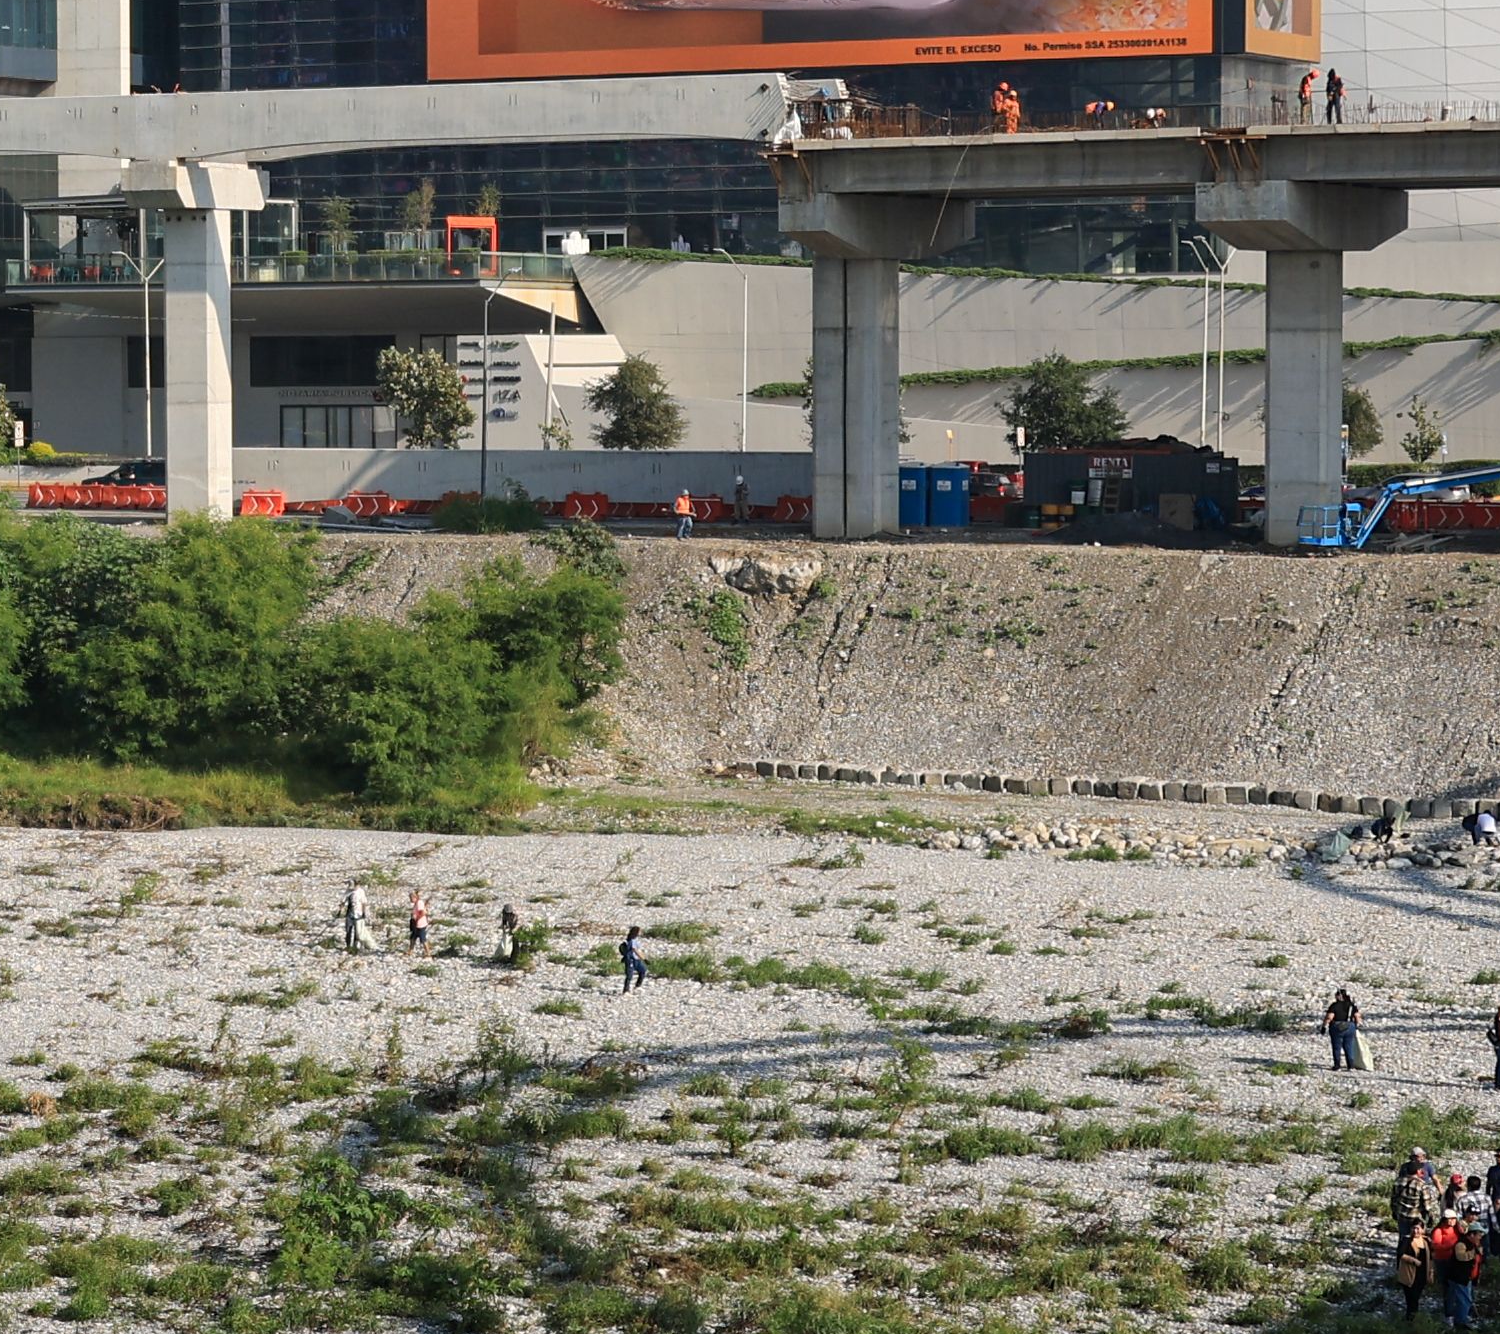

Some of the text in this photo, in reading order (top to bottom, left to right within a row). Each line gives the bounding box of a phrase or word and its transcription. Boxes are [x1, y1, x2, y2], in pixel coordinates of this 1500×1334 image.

[915, 46, 943, 56] EVITE
[946, 46, 958, 55] EL
[961, 44, 1001, 54] EXCESO
[1024, 42, 1040, 52] No.
[1043, 41, 1082, 51] Permiso
[1085, 39, 1105, 49] SSA
[1094, 457, 1129, 467] RENTA
